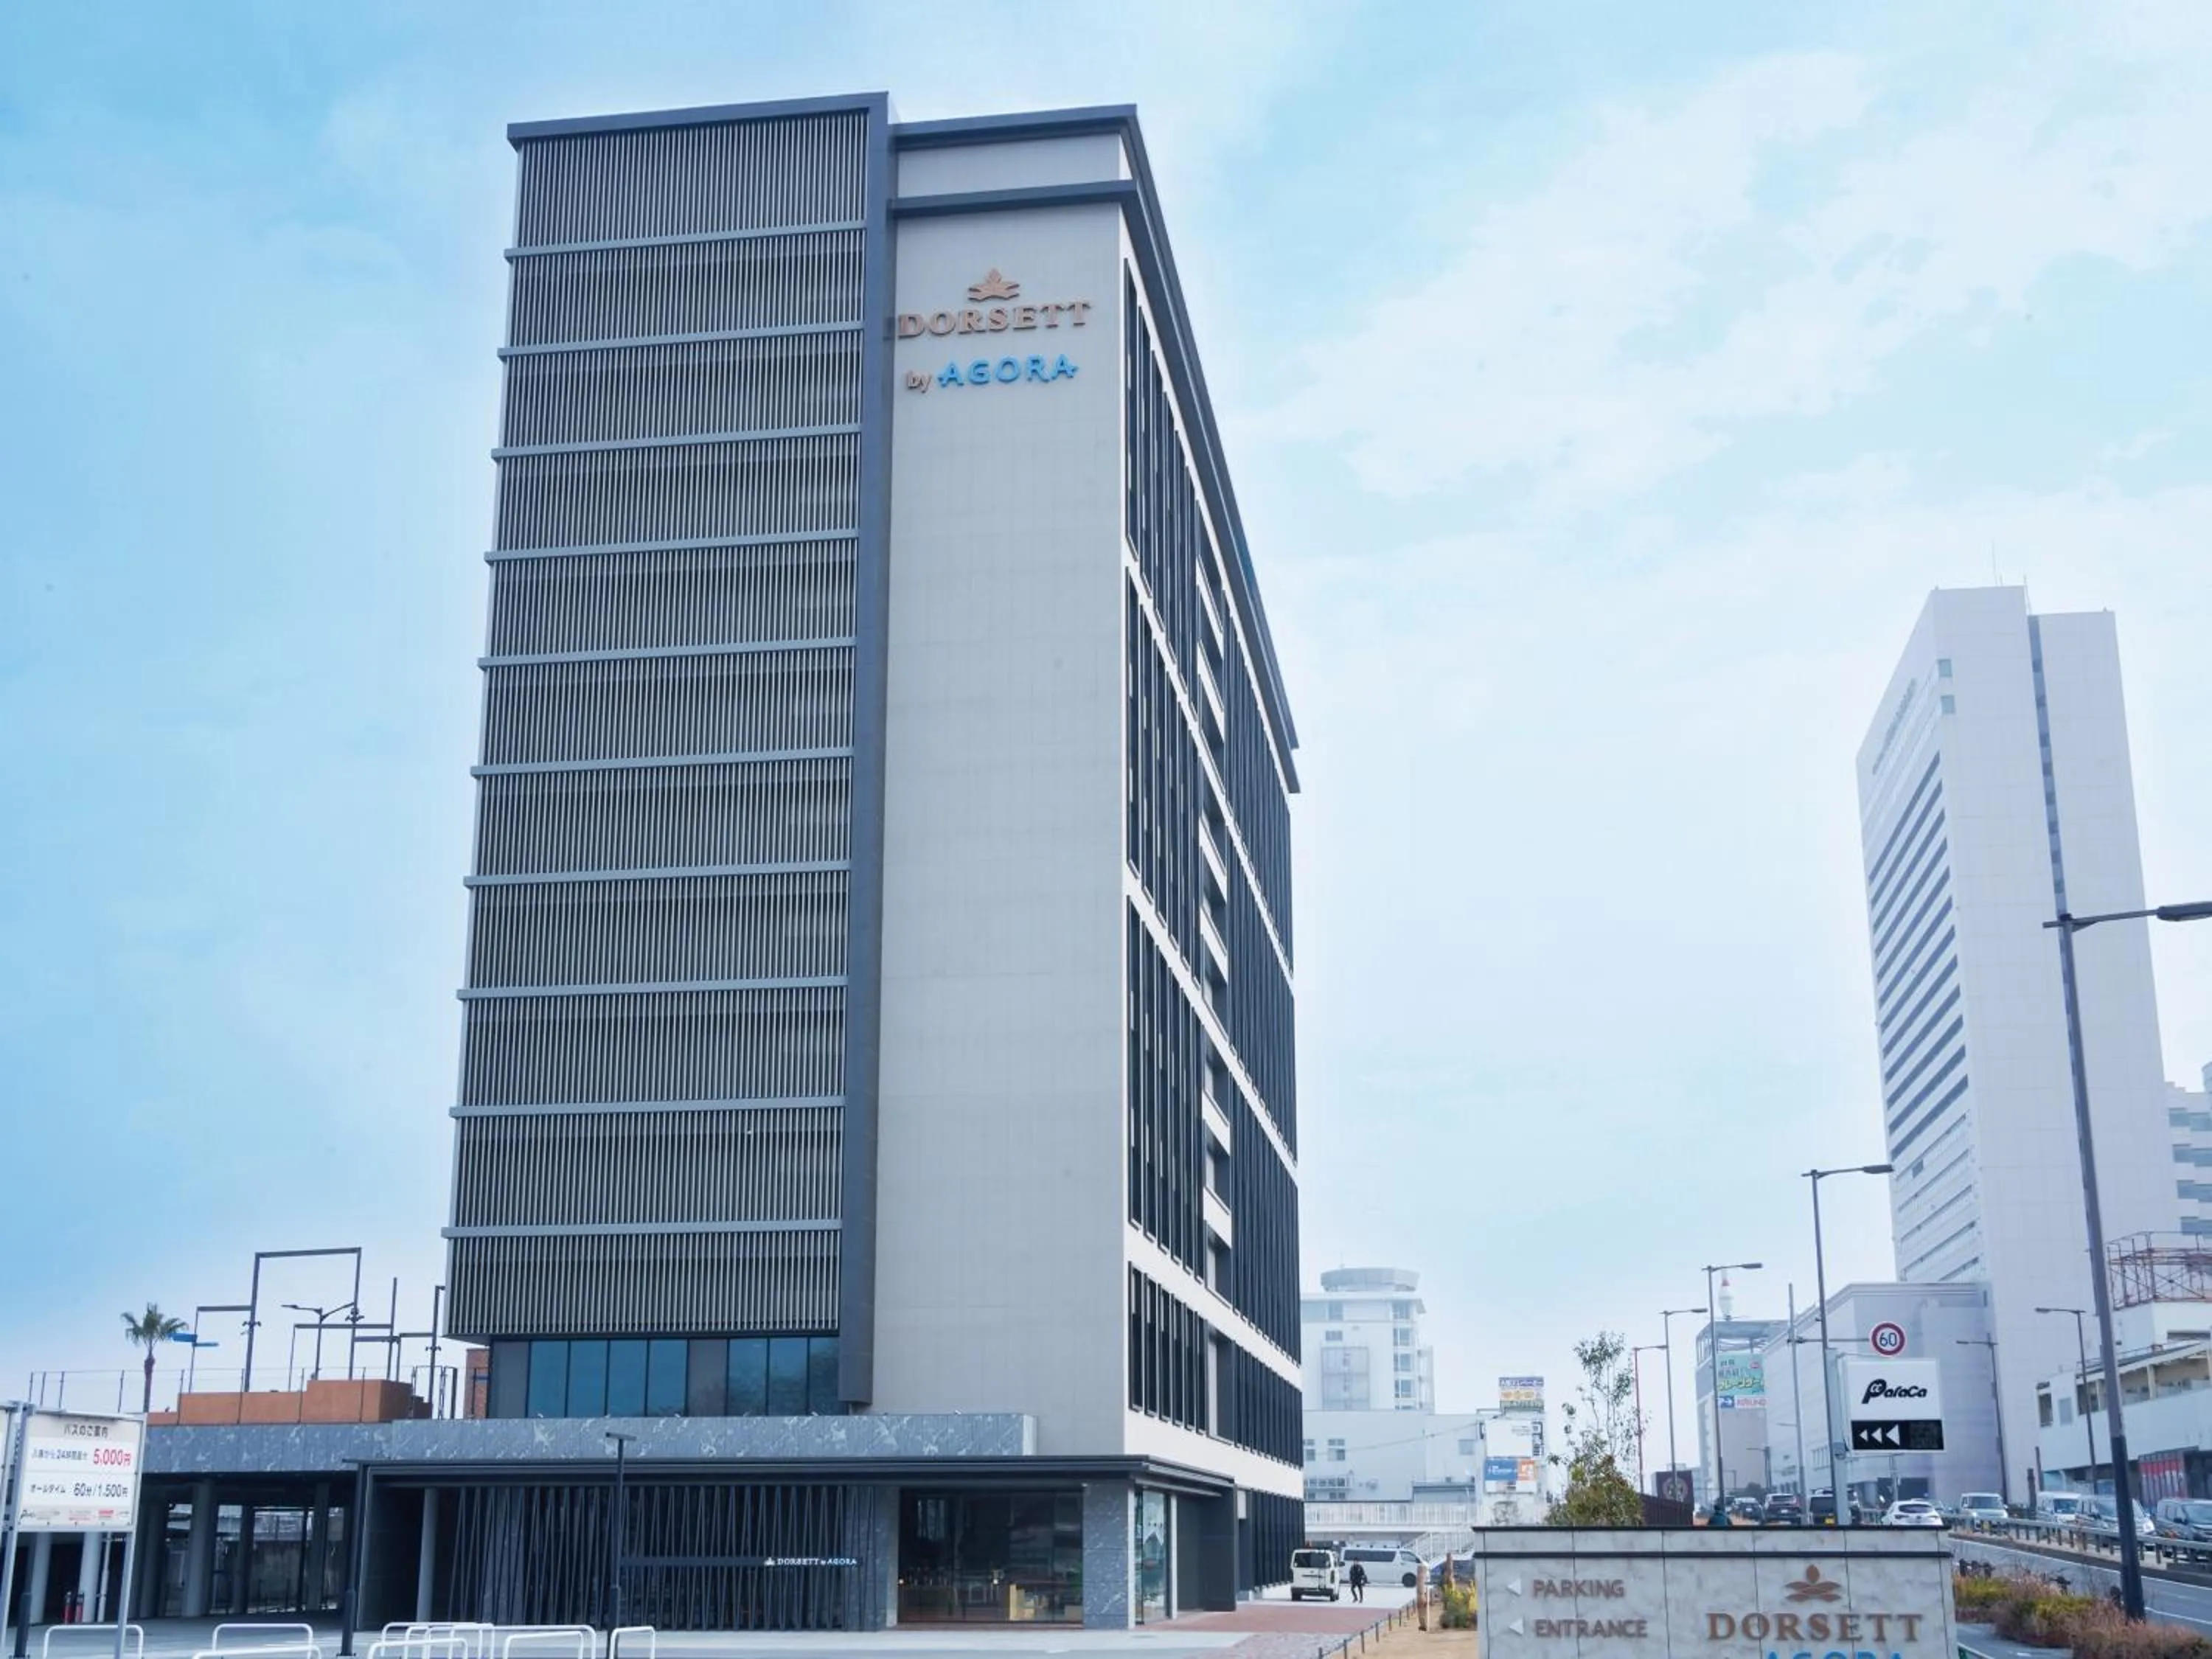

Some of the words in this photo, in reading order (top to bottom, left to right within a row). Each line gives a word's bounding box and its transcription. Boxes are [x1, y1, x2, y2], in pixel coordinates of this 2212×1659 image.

[898, 300, 1091, 338] DORSETT
[906, 370, 932, 393] by
[937, 353, 1079, 388] AGORA
[1879, 1332, 1897, 1346] 60
[1533, 1579, 1625, 1599] PARKING
[1535, 1618, 1649, 1638] ENTRANCE
[1705, 1612, 1923, 1643] DORSETT
